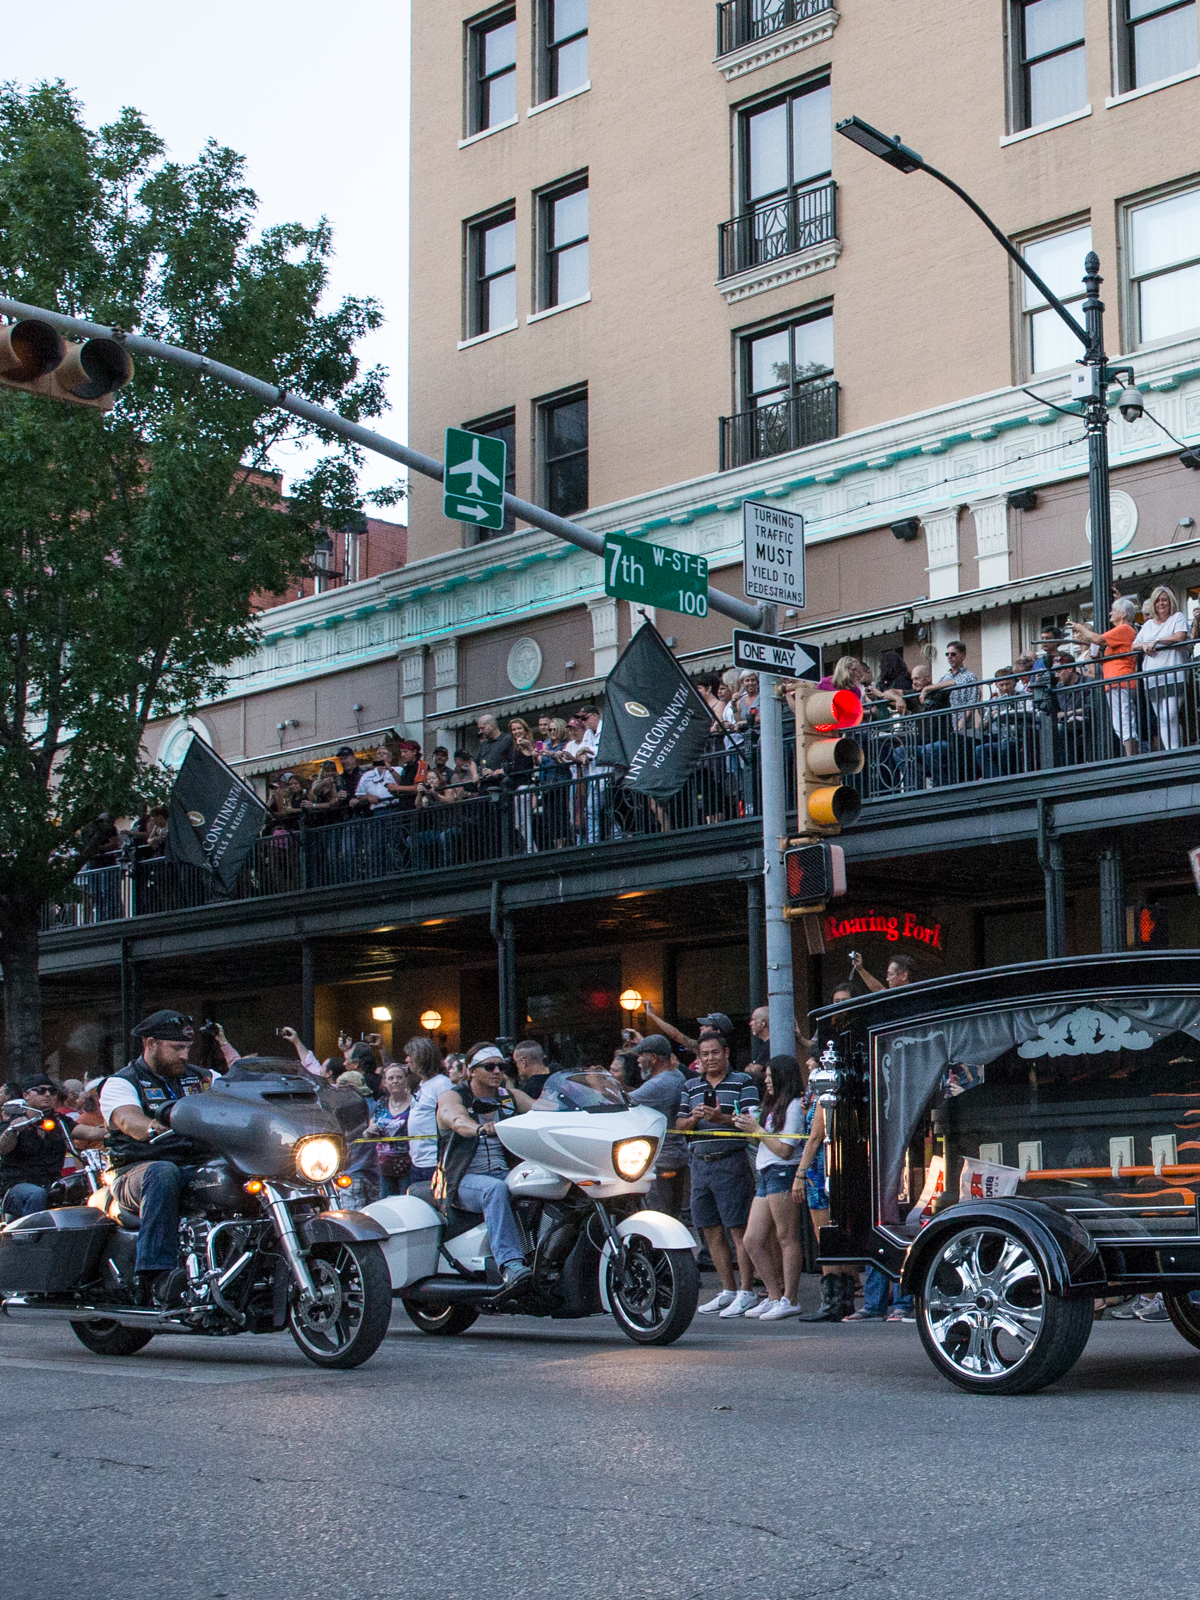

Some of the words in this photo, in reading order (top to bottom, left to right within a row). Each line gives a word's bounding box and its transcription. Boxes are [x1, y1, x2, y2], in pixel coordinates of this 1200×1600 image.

[754, 508, 794, 529] TURNING
[755, 524, 794, 545] TRAFFIC
[606, 542, 644, 587] 7th
[653, 546, 706, 578] W-ST-E
[756, 542, 793, 567] MUST
[752, 565, 778, 582] YIELD
[783, 572, 795, 585] TO
[679, 590, 707, 616] 100
[748, 581, 803, 603] PEDESTRIANS
[744, 643, 766, 661] ONE
[773, 649, 796, 666] WAY
[652, 738, 676, 769] HOTELS
[212, 840, 228, 868] OTELS
[825, 909, 899, 941] Roaring
